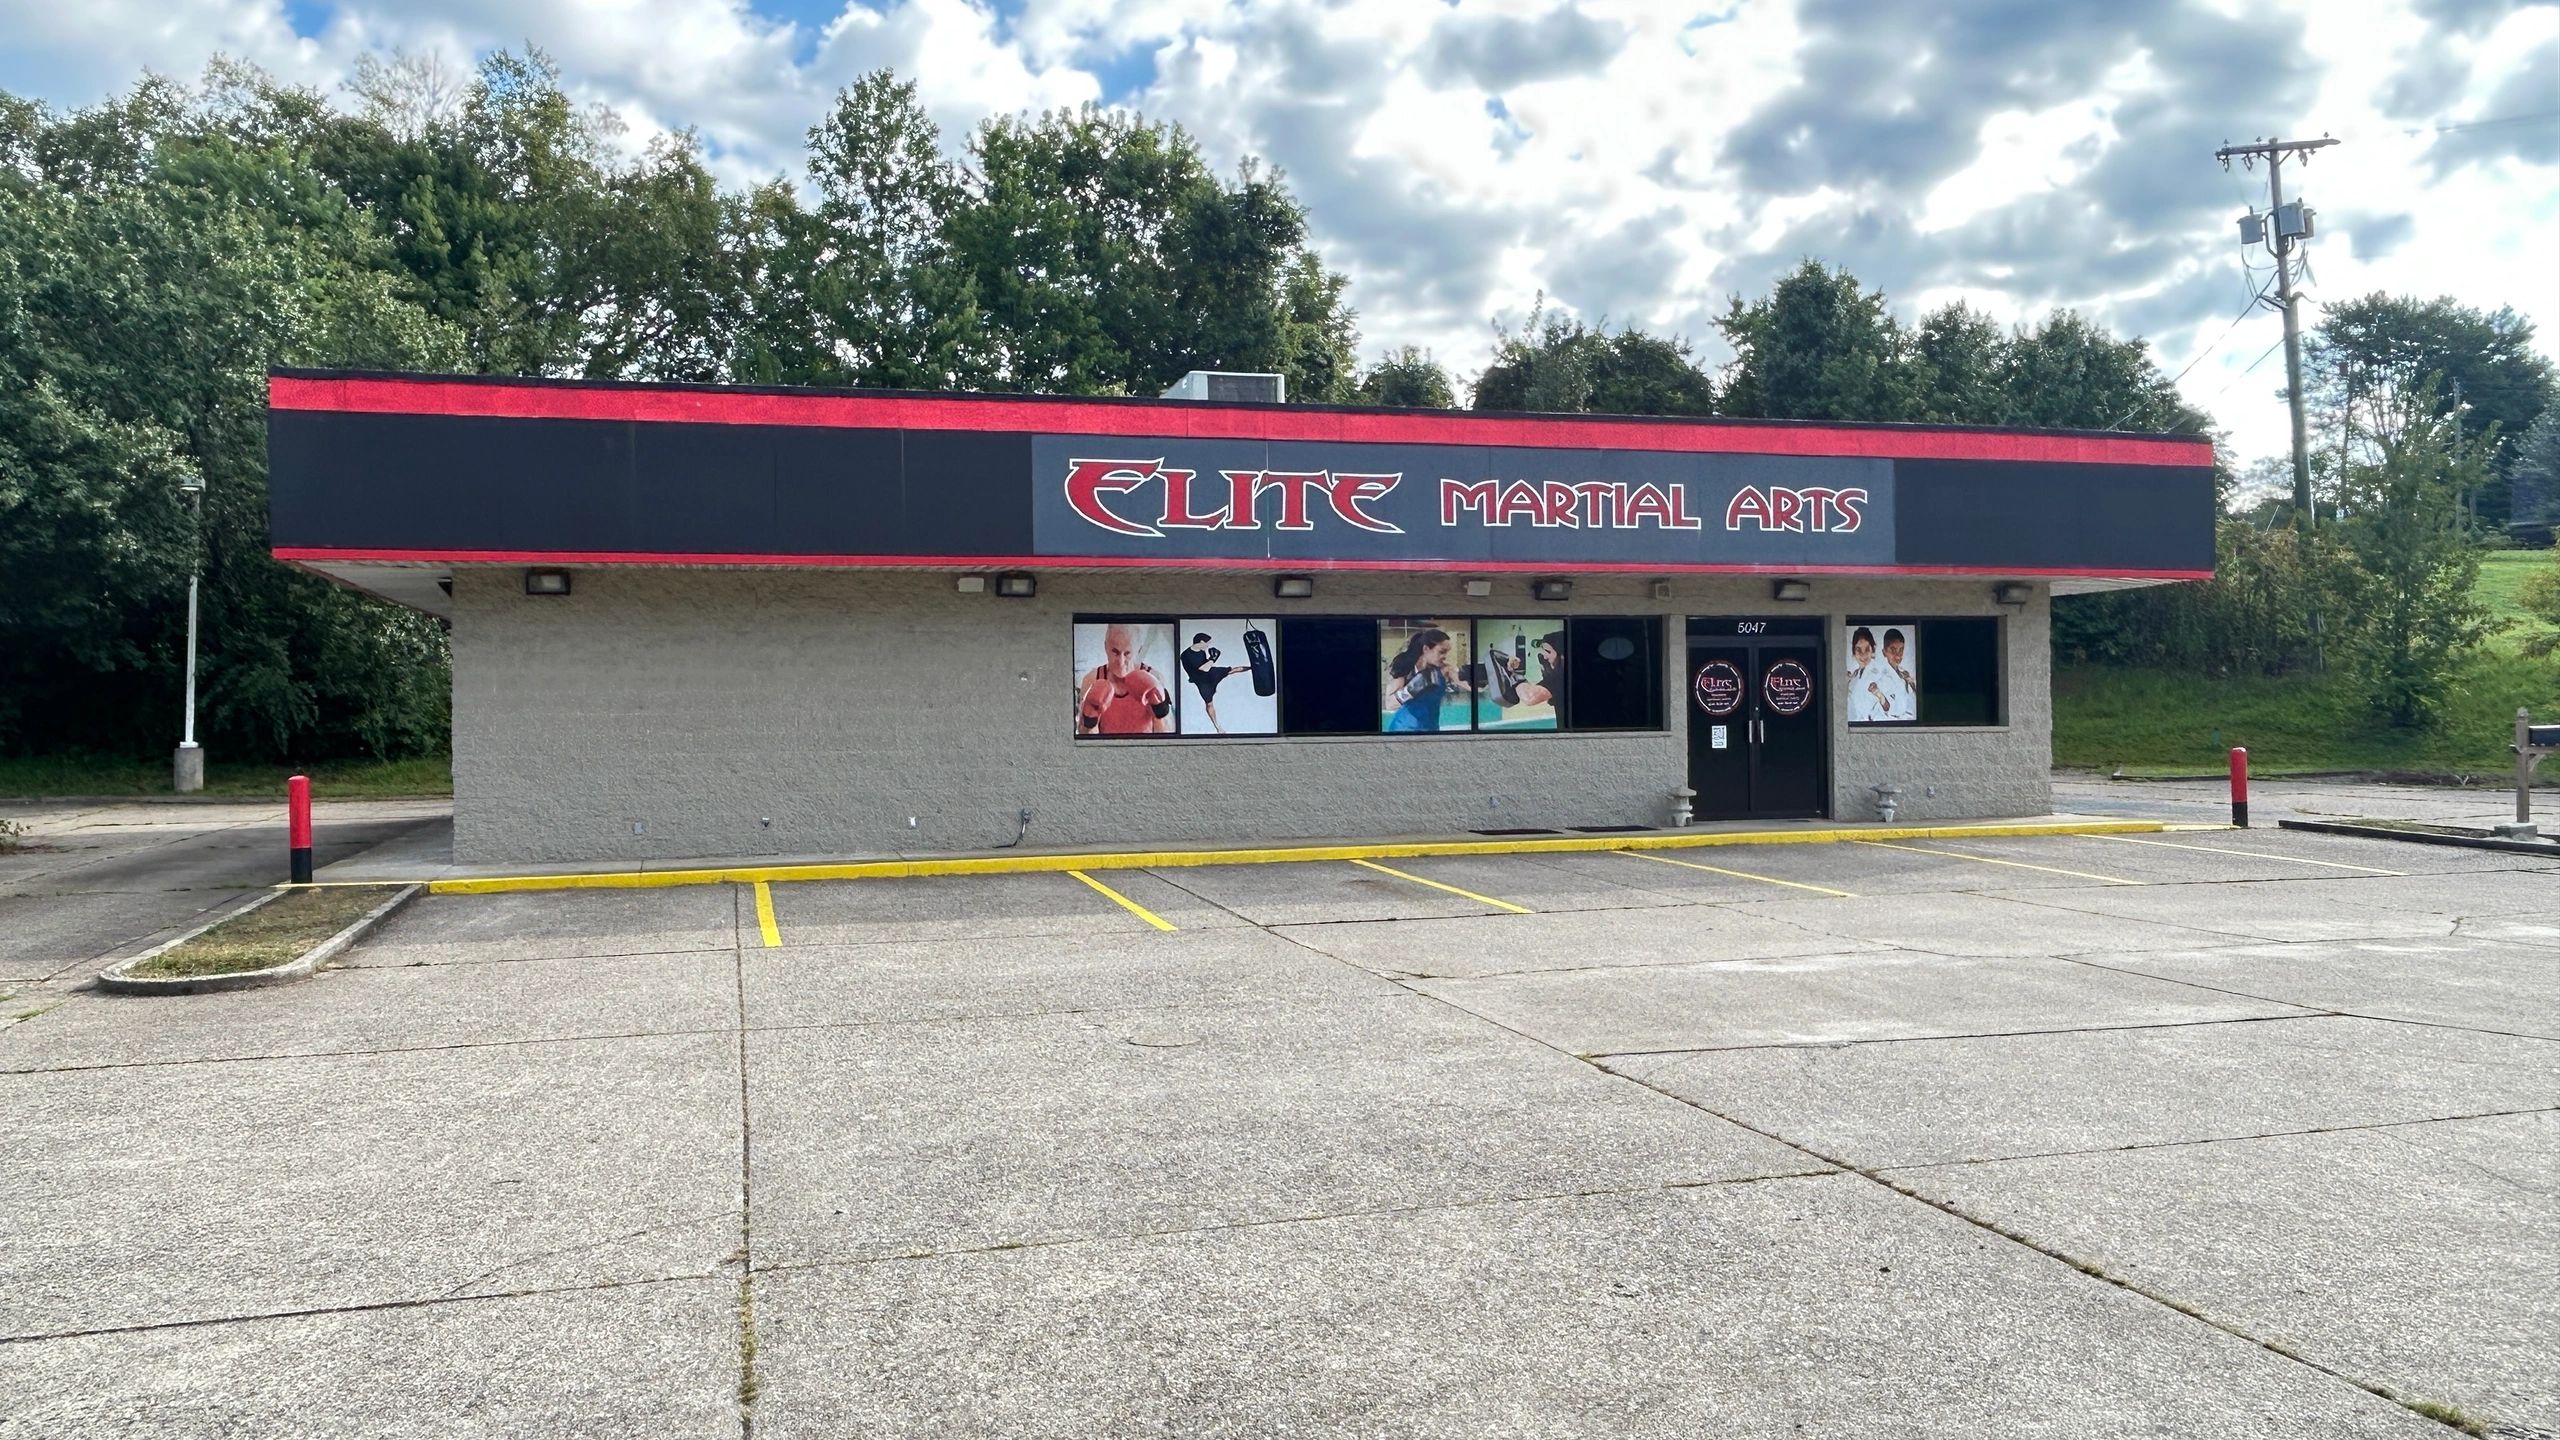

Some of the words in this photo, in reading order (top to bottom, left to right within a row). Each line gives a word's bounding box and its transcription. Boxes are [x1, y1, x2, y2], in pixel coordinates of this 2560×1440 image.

[1064, 457, 1405, 538] ELITE
[1440, 478, 1701, 530] MARTIAL
[1726, 485, 1868, 533] ARTS
[1737, 622, 1767, 634] 5047
